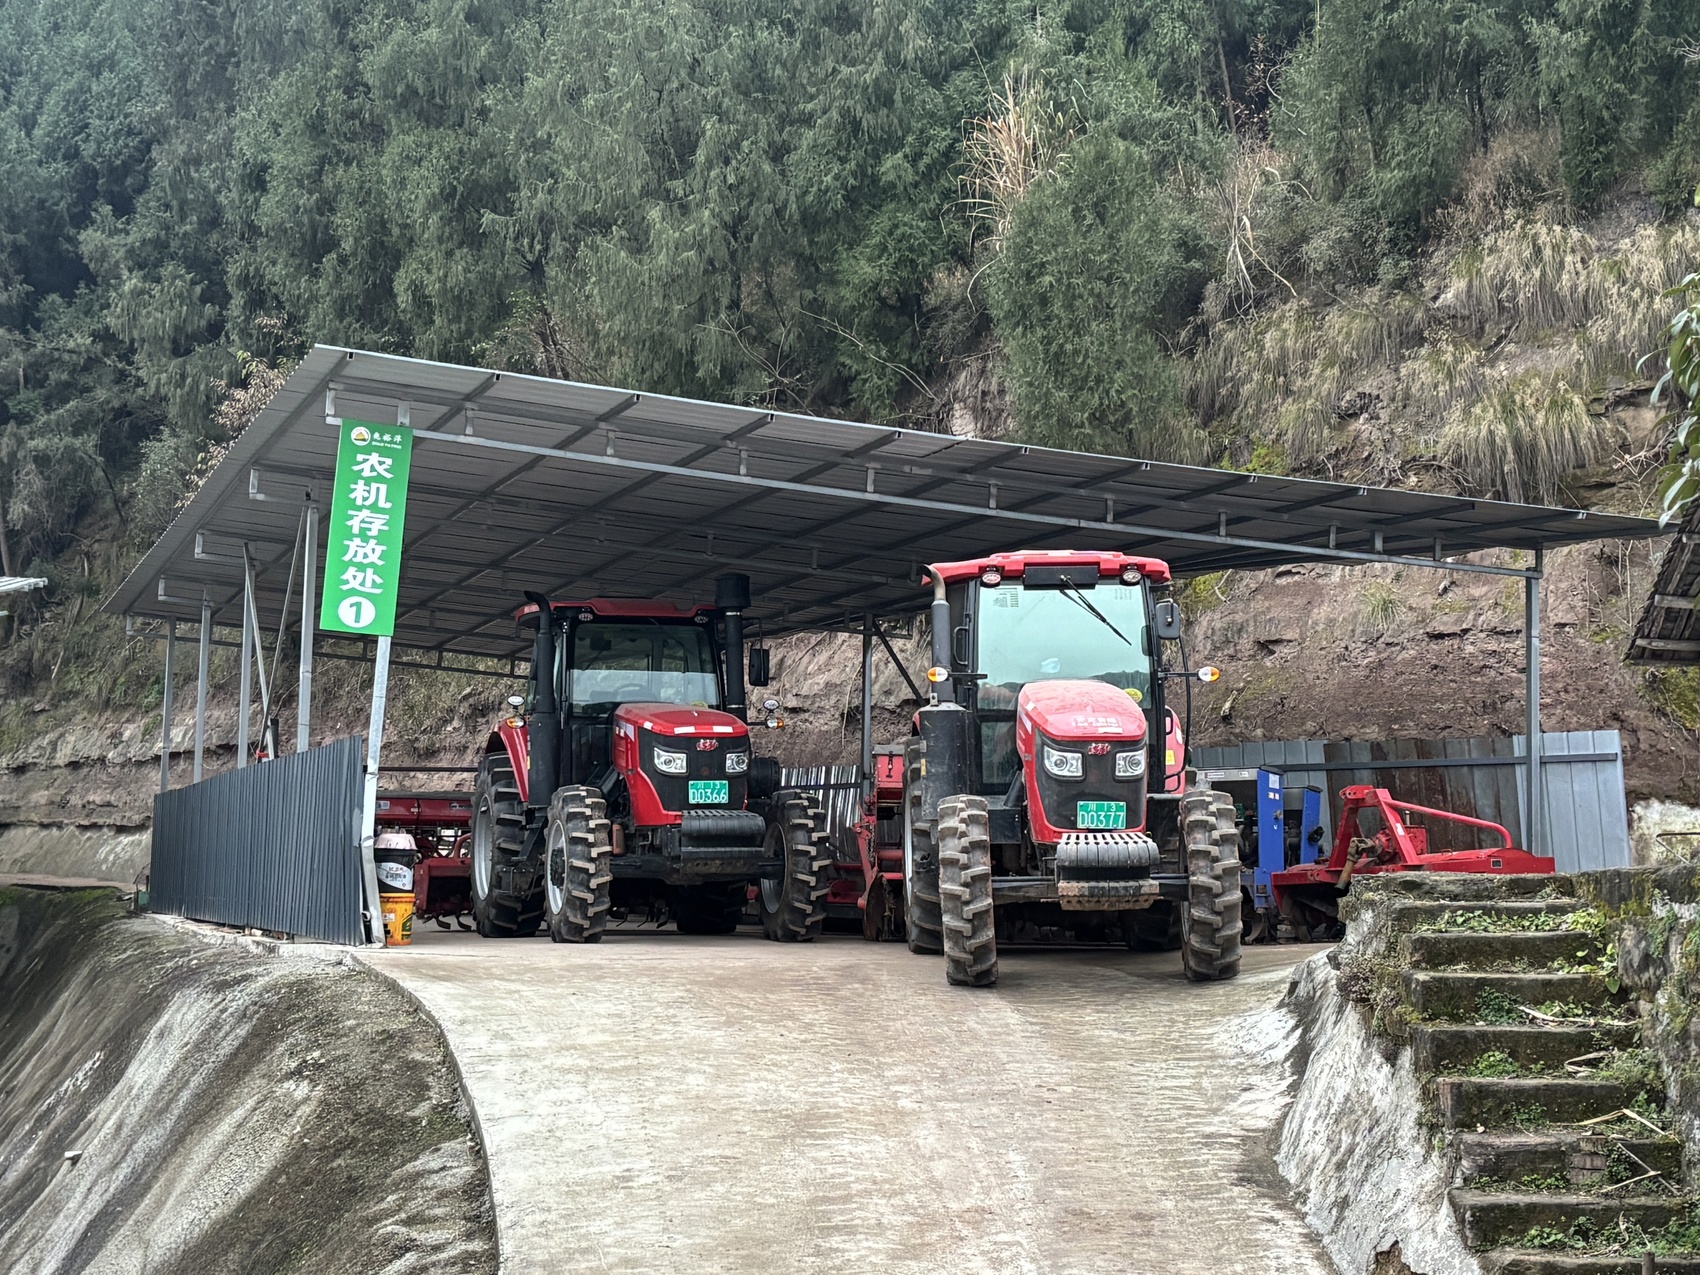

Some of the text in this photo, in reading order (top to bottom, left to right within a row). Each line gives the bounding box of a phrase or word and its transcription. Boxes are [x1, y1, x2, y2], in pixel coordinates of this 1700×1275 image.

[339, 452, 394, 594] 农机存放处
[690, 788, 727, 802] D0366
[1079, 811, 1125, 828] D0377
